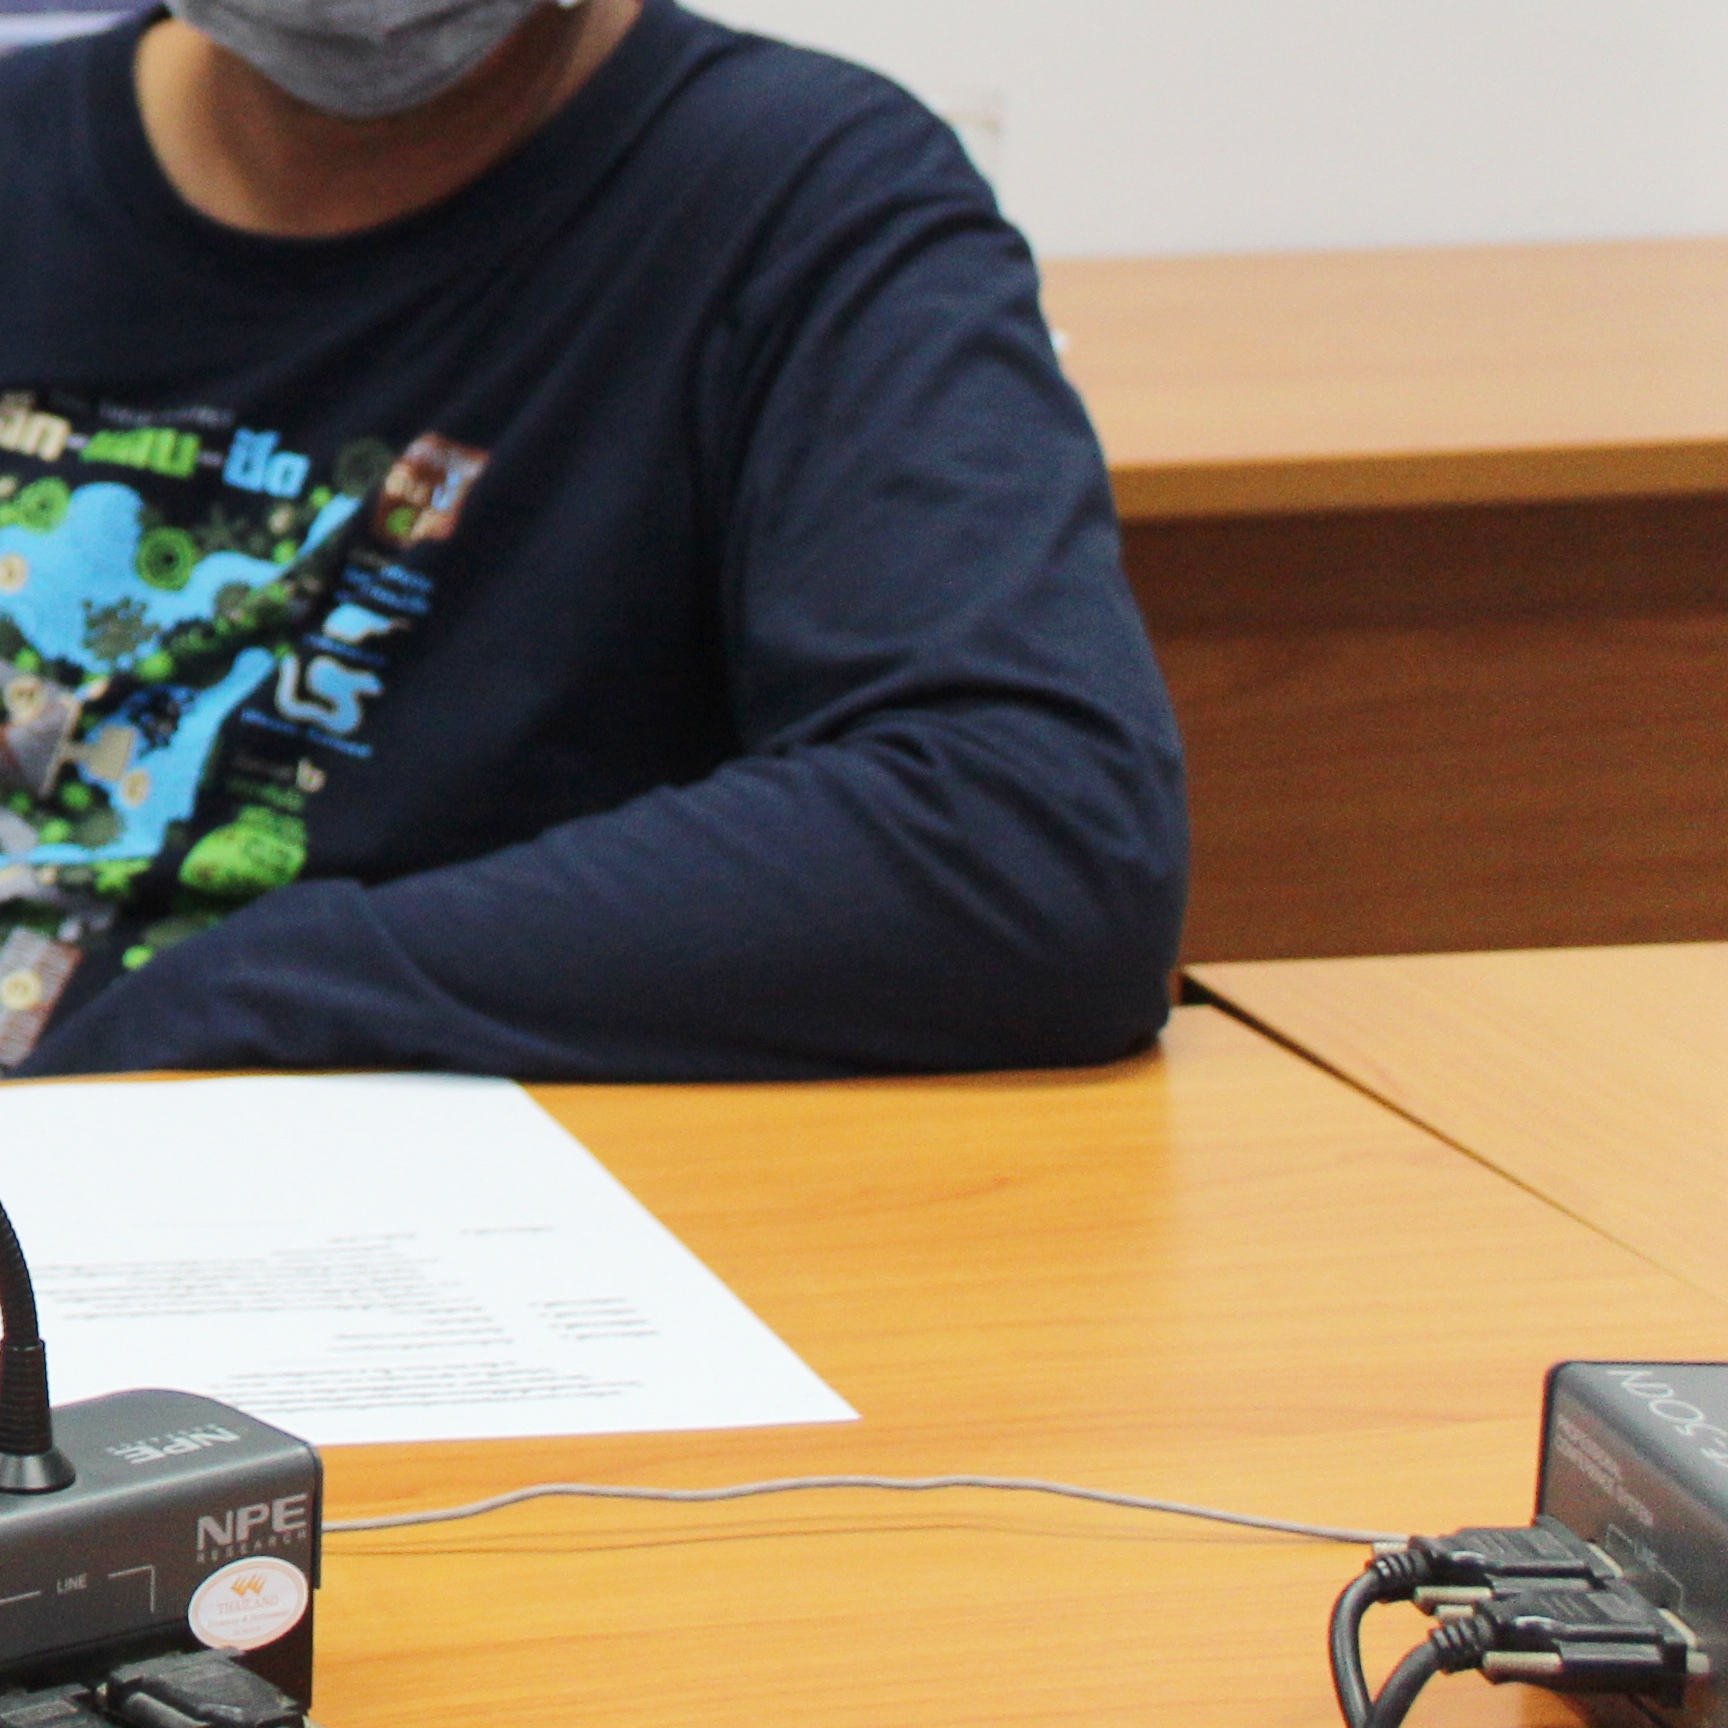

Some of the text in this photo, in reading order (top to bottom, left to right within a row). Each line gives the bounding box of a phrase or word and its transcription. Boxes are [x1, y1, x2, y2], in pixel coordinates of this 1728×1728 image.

[196, 1492, 309, 1553] NPE
[196, 1529, 308, 1564] RESEARCH
[56, 1572, 89, 1596] LINE
